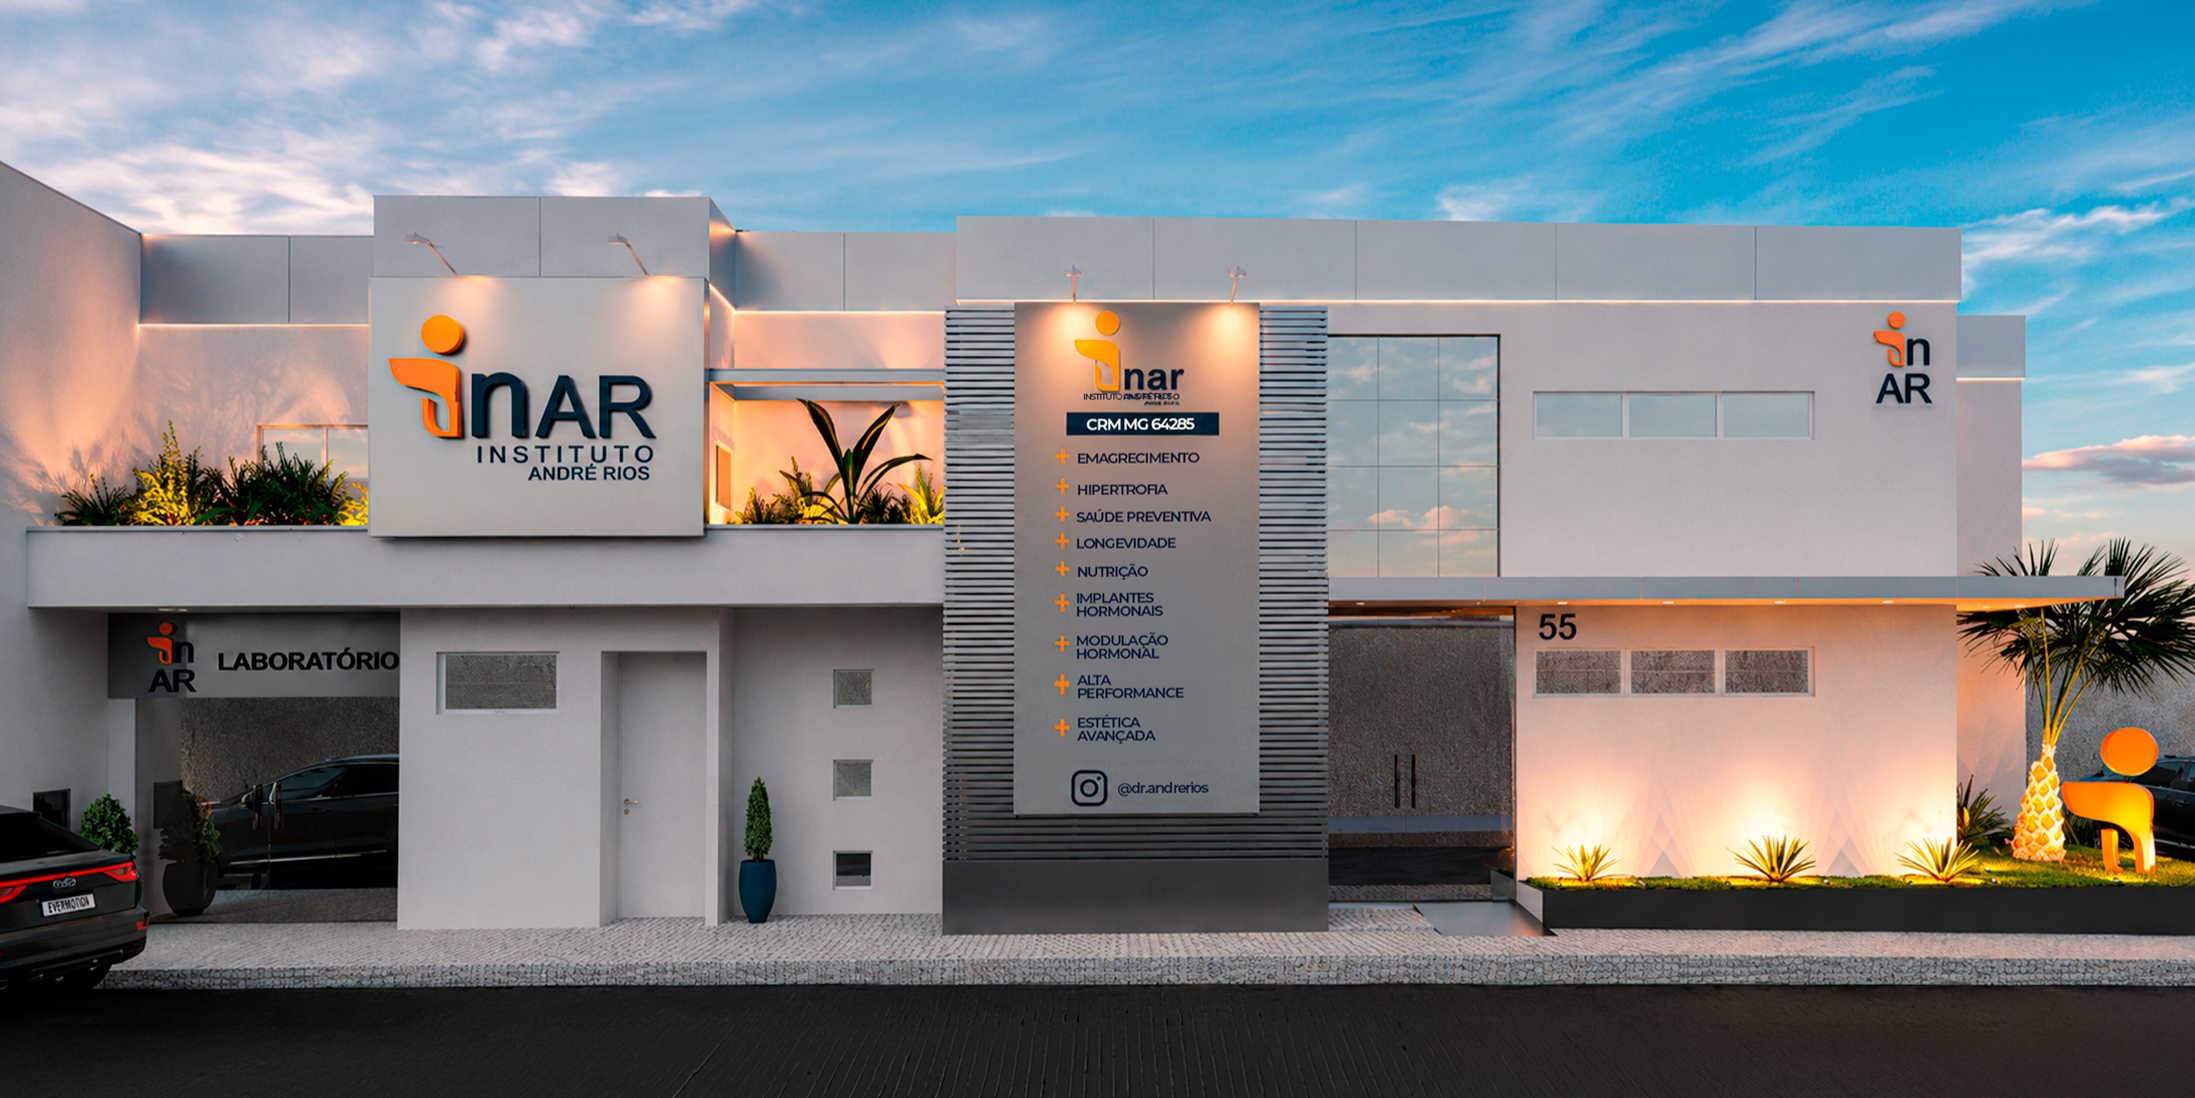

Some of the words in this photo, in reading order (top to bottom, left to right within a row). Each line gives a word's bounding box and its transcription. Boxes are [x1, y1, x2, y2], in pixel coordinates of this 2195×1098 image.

[1876, 373, 1932, 404] AR
[1086, 418, 1121, 430] CRM
[1124, 418, 1148, 430] MG
[1151, 418, 1195, 430] 64285
[477, 445, 654, 463] INSTITUTO
[1077, 452, 1200, 464] EMAGRECIMENTO
[528, 463, 597, 481] ANDRÉ
[603, 466, 650, 480] RIOS
[1077, 484, 1168, 495] HIPERTROFIA
[1076, 508, 1124, 523] SAÚDE
[1127, 511, 1212, 522] PREVENTIVA
[1076, 537, 1176, 549] LONGEVIDADE
[1077, 563, 1148, 580] NUTRIÇÃO
[1076, 592, 1154, 604] IMPLANTES
[1076, 605, 1164, 617] HORMONAIS
[1539, 614, 1577, 640] 55
[1076, 632, 1169, 649] MODULAÇÃO
[218, 647, 399, 671] LABORATÓRIO
[1076, 648, 1159, 660] HORMONAL
[148, 669, 196, 692] AR
[1077, 675, 1111, 686] ALTA
[1077, 687, 1184, 699] PERFORMANCE
[1077, 714, 1141, 728] ESTÉTICA
[1077, 730, 1156, 744] AVANÇADA
[1117, 781, 1209, 797] @dr.andrerios
[48, 896, 89, 913] EVERMOTION
